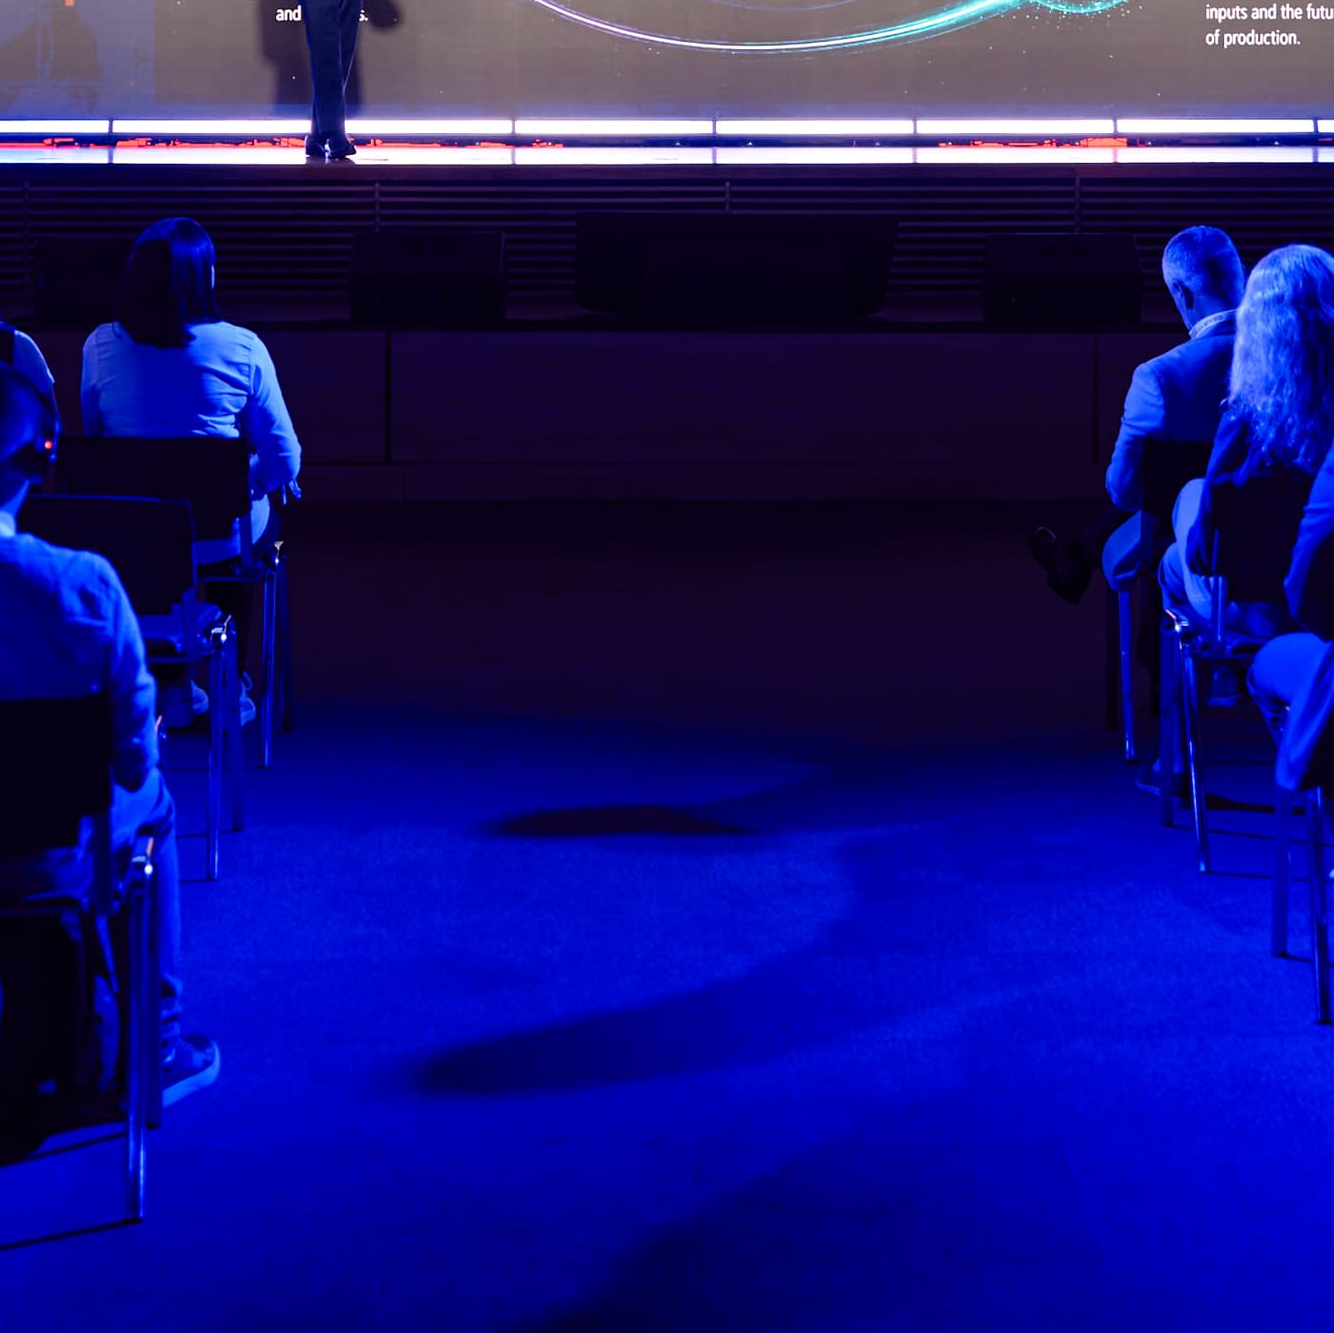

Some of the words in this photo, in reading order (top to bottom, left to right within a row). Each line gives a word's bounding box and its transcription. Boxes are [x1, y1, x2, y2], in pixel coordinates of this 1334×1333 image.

[276, 5, 302, 21] and
[1205, 4, 1248, 23] inputs
[1251, 3, 1277, 20] and
[1280, 3, 1303, 20] the
[1205, 29, 1220, 45] of
[1224, 29, 1301, 48] production.
